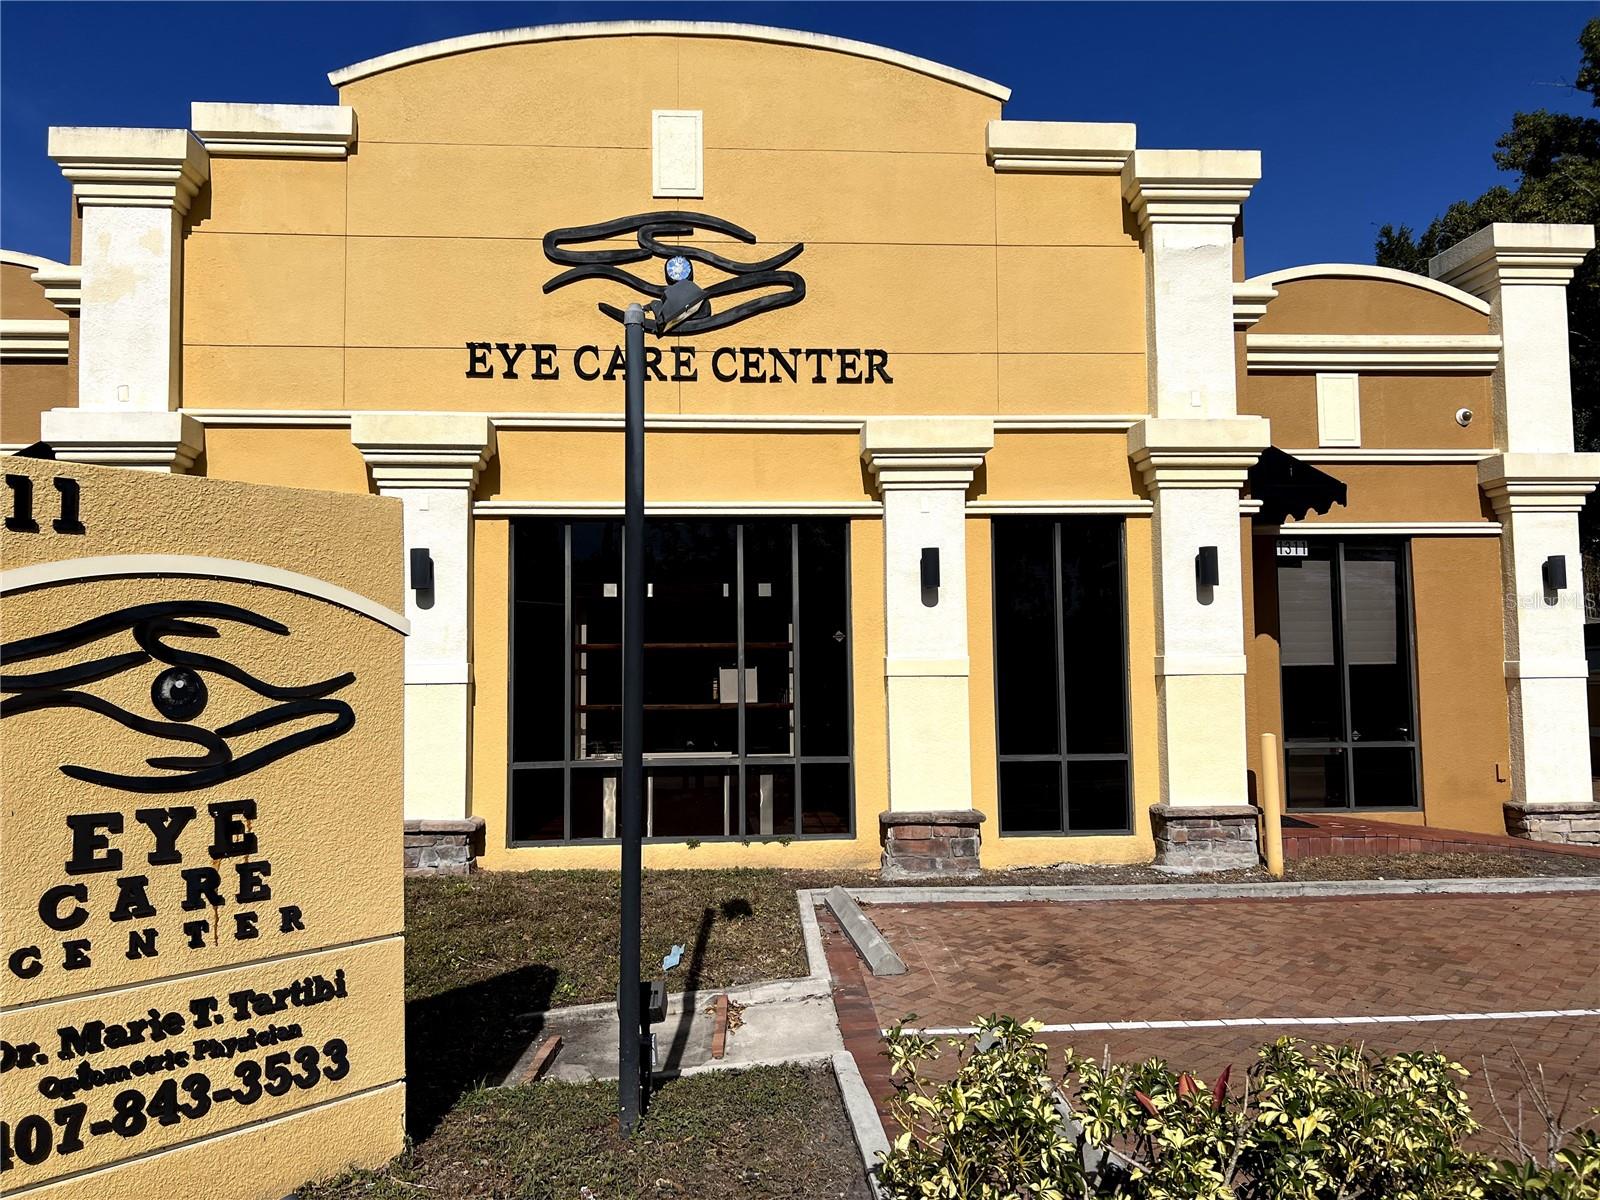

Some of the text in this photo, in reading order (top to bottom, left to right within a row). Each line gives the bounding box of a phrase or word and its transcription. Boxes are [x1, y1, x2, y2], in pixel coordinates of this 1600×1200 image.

[465, 342, 893, 384] EYE CARE CENTER
[1277, 540, 1307, 555] 1311
[65, 799, 257, 875] EYE
[38, 861, 271, 931] CARE
[8, 905, 305, 979] CENTER
[57, 1008, 185, 1061] Marie
[189, 996, 224, 1029] T.
[228, 969, 348, 1021] Tartibi
[38, 1023, 303, 1100] Optometric Physician
